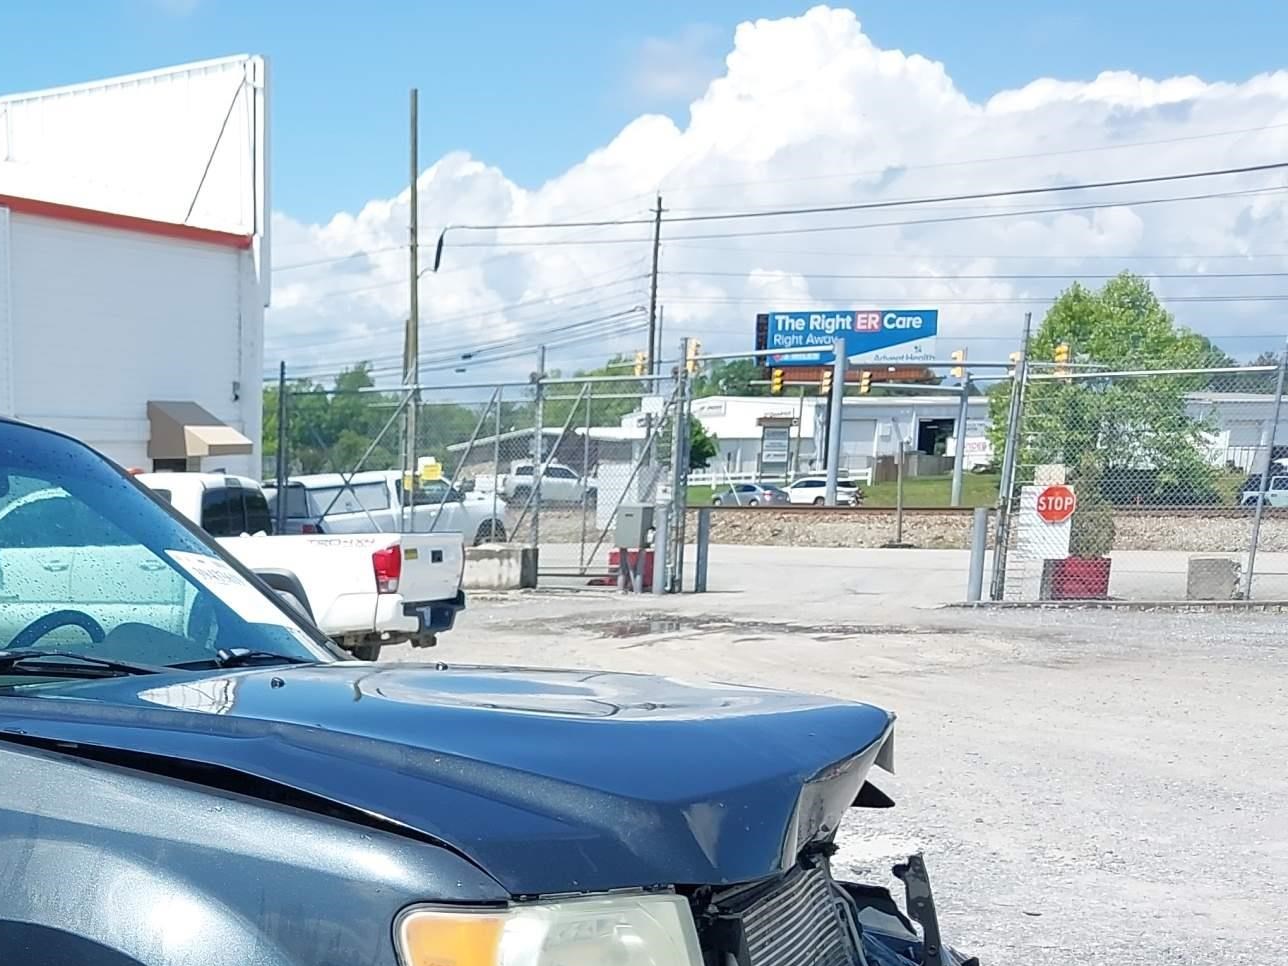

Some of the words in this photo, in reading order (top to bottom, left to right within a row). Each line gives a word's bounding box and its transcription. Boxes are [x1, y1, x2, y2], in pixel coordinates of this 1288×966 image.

[774, 314, 806, 331] The
[809, 313, 852, 334] Right
[856, 313, 880, 330] ER
[883, 312, 923, 329] Care
[773, 334, 803, 348] Right
[1038, 496, 1074, 511] STOP
